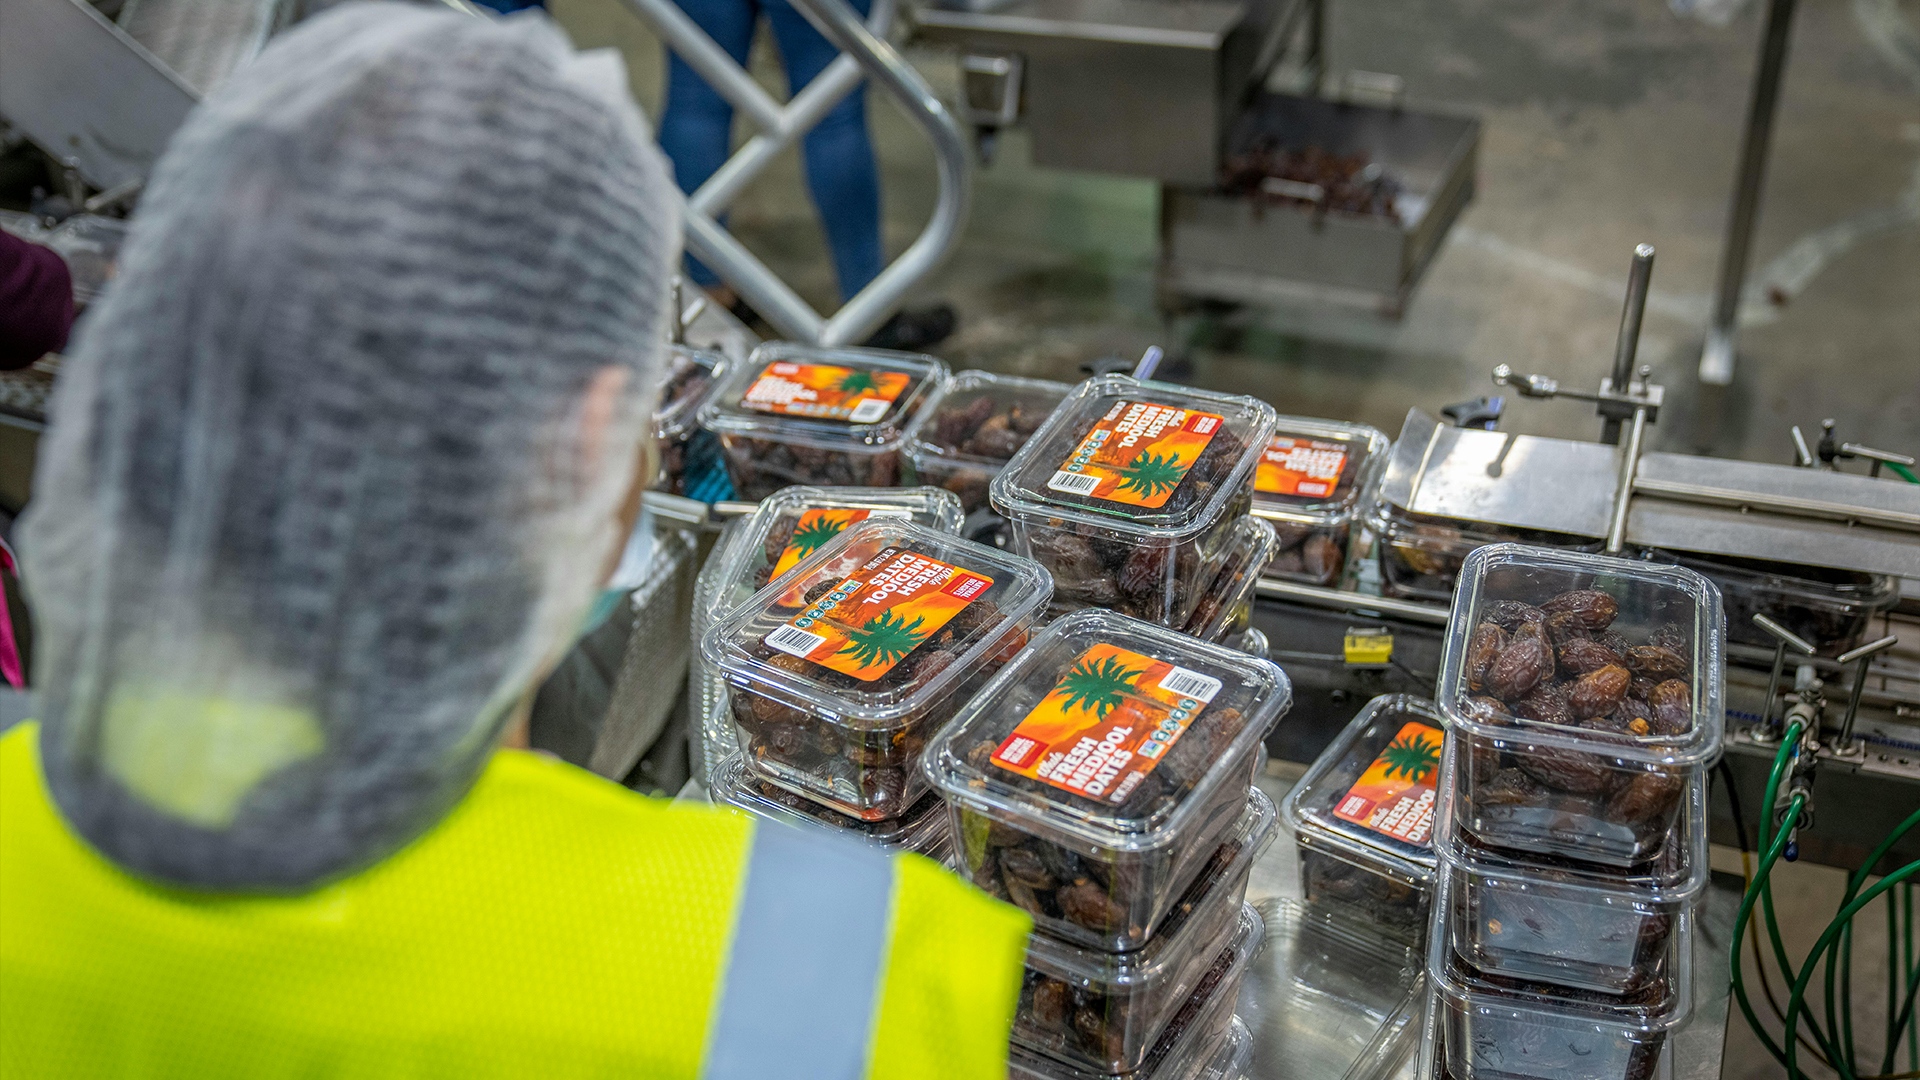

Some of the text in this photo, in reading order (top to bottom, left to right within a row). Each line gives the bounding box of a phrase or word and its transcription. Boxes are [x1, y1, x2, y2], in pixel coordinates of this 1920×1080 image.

[1117, 404, 1147, 432] DATES
[1118, 406, 1161, 448] MEDJOOL
[1144, 409, 1176, 438] FRESH
[863, 557, 930, 604] MEDJOOL
[869, 554, 916, 586] DATES
[896, 562, 944, 596] FRESH
[929, 567, 954, 585] Whole
[953, 578, 977, 595] DELIGHTS
[959, 580, 985, 598] NATURAL
[1037, 752, 1064, 777] Whole
[1046, 737, 1098, 783] FRESH
[1064, 726, 1133, 789] MEDJOOL
[1081, 748, 1132, 796] DATES
[1380, 796, 1415, 832] FRESH
